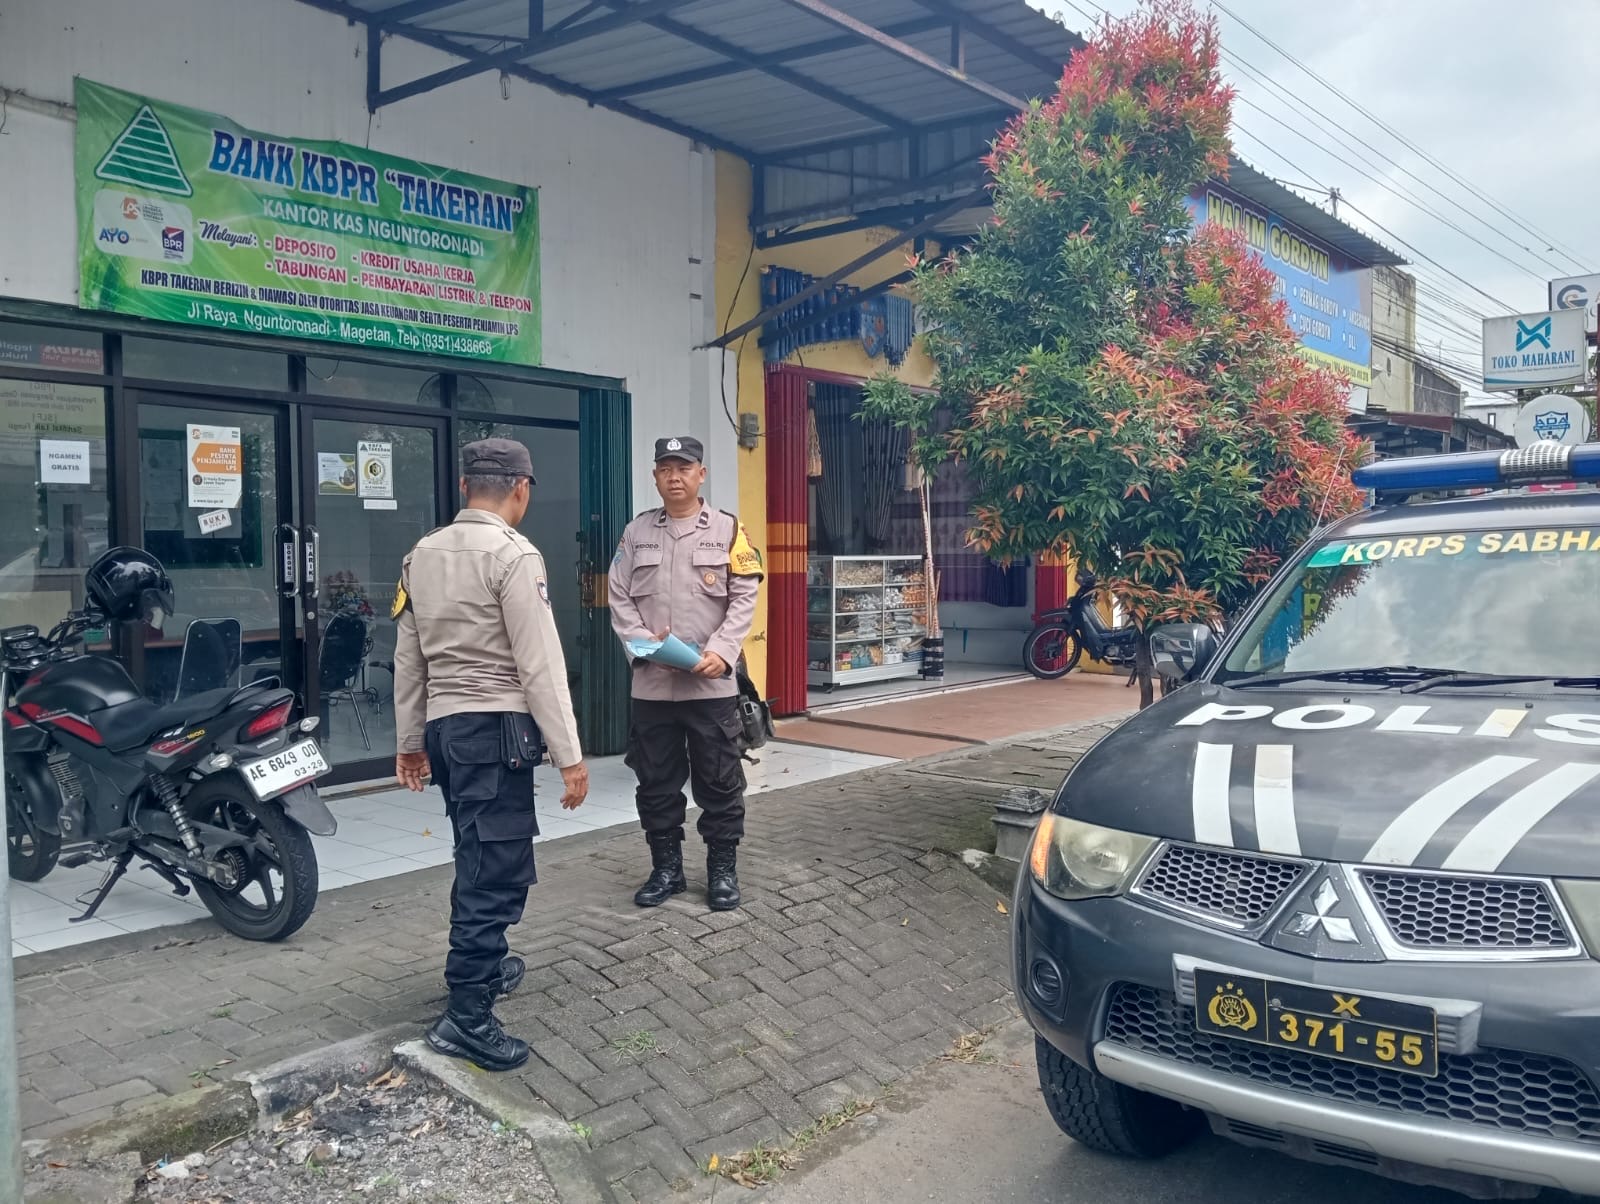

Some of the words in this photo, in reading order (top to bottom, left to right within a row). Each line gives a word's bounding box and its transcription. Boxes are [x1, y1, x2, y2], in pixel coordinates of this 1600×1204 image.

[208, 130, 295, 188] BANK
[301, 151, 378, 205] KBPR
[99, 227, 130, 244] AYO
[263, 199, 329, 229] KANTOR
[333, 213, 363, 235] KAS
[368, 219, 484, 256] NGUNTORONADI
[163, 238, 184, 250] BPR
[275, 236, 336, 260] DEPOSITO
[1270, 224, 1328, 282] GORDYN
[275, 259, 346, 283] TABUNGAN
[361, 252, 400, 271] KREDIT
[403, 260, 440, 278] USAHA
[443, 266, 475, 284] KERJA
[141, 269, 168, 287] KBPR
[170, 273, 212, 292] TAKERAN
[213, 280, 249, 299] BERIZIN
[250, 288, 257, 300] &
[258, 287, 297, 305] DIAWASI
[298, 293, 318, 308] OLEH
[319, 296, 359, 314] OTORITAS
[361, 301, 380, 316] JASA
[380, 304, 418, 322] KEUANGAN
[419, 310, 442, 325] SERTA
[442, 313, 472, 328] PESERTA
[472, 318, 505, 335] PENJAMIN
[506, 323, 519, 336] LPS
[361, 273, 435, 297] PEMBAYARAN
[438, 285, 476, 304] LISTRIK
[478, 292, 487, 305] &
[489, 293, 532, 312] TELEPON
[203, 305, 238, 327] Raya
[243, 309, 330, 336] Nguntoronadi
[340, 322, 394, 346] Magetan,
[397, 329, 420, 350] Telp
[421, 333, 492, 355] (0351)438668
[1491, 355, 1518, 369] TOKO
[1522, 350, 1575, 367] MAHARANI
[1536, 417, 1569, 426] ADA
[699, 541, 725, 549] POLRI
[1340, 534, 1466, 563] KORPS
[1176, 702, 1600, 746] POLIS
[250, 764, 267, 782] AE
[268, 751, 298, 773] 6849
[1332, 994, 1362, 1017] X
[1279, 1014, 1424, 1066] 371-55
